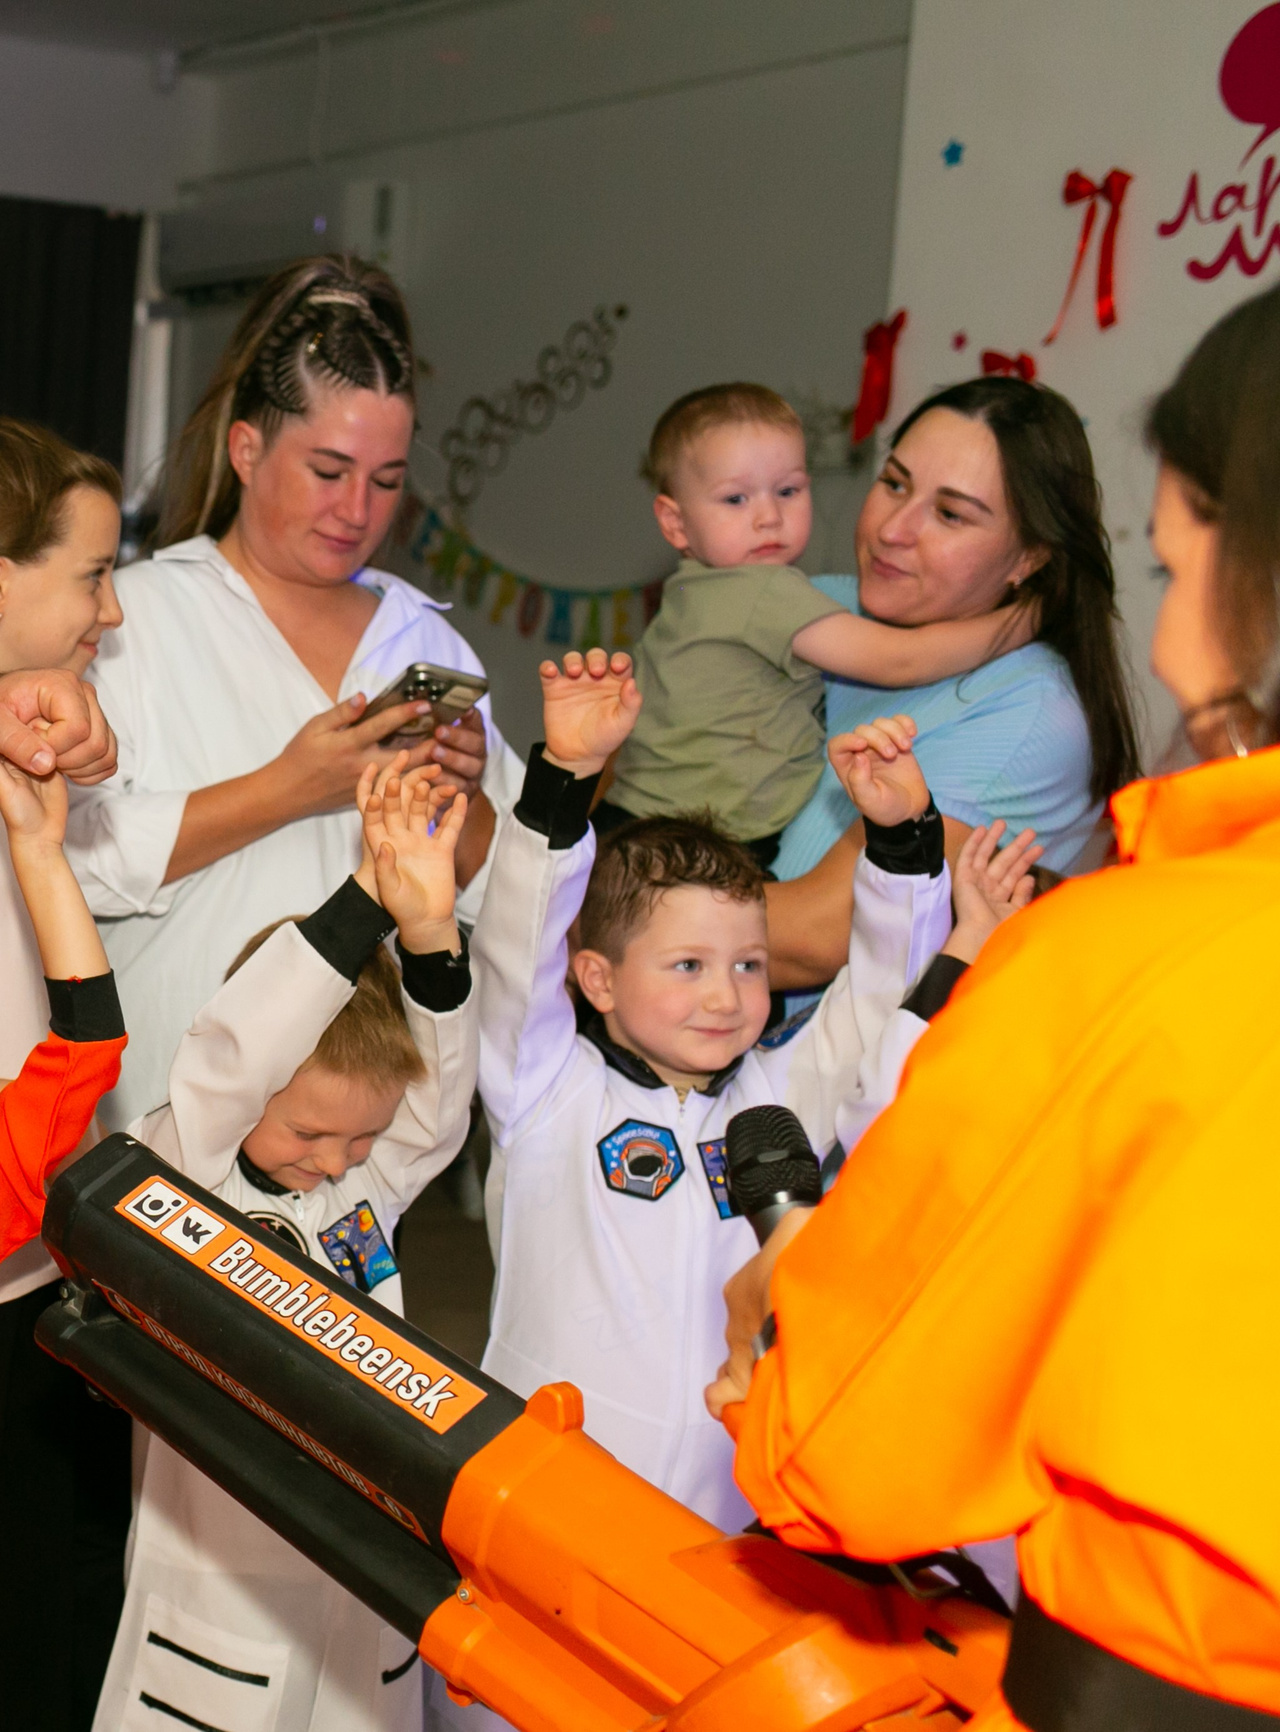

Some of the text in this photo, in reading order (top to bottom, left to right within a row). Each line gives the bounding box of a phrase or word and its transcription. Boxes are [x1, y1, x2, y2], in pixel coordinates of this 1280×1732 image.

[144, 1317, 370, 1495] ОТРЯД КОСМОНАВТОВ
[208, 1237, 457, 1421] Bumblebeensk
